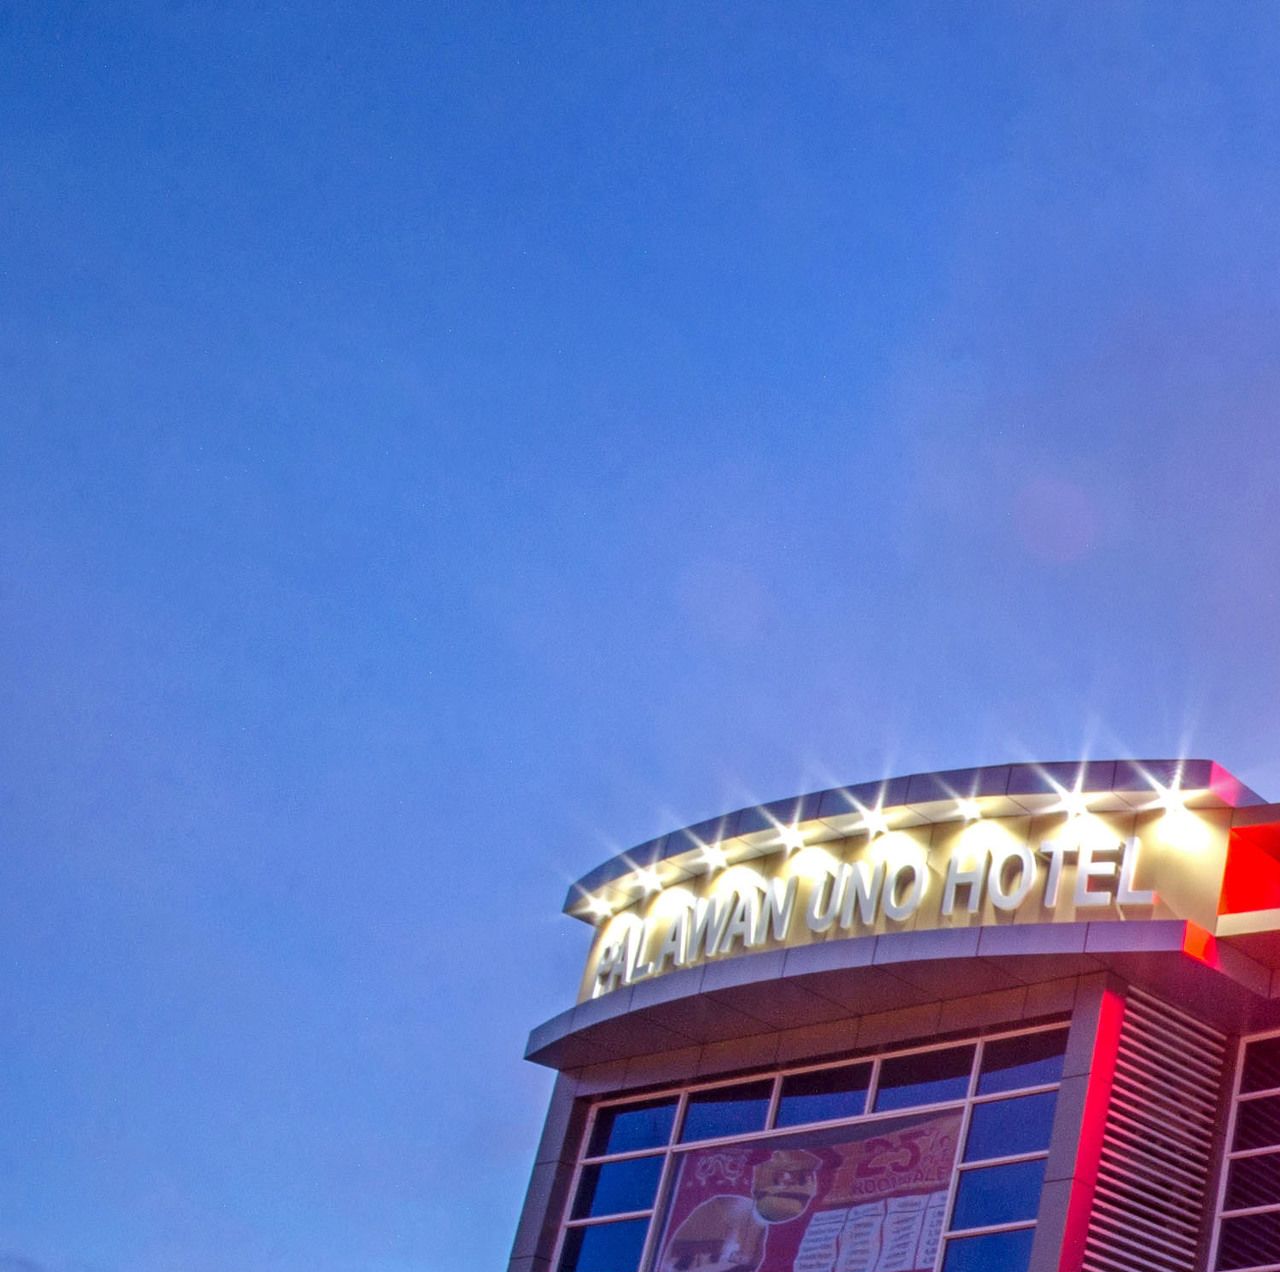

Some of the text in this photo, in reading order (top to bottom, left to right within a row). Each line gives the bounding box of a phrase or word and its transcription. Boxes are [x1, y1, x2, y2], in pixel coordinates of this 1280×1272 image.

[593, 837, 1158, 1000] PALAWAN UNO HOTEL
